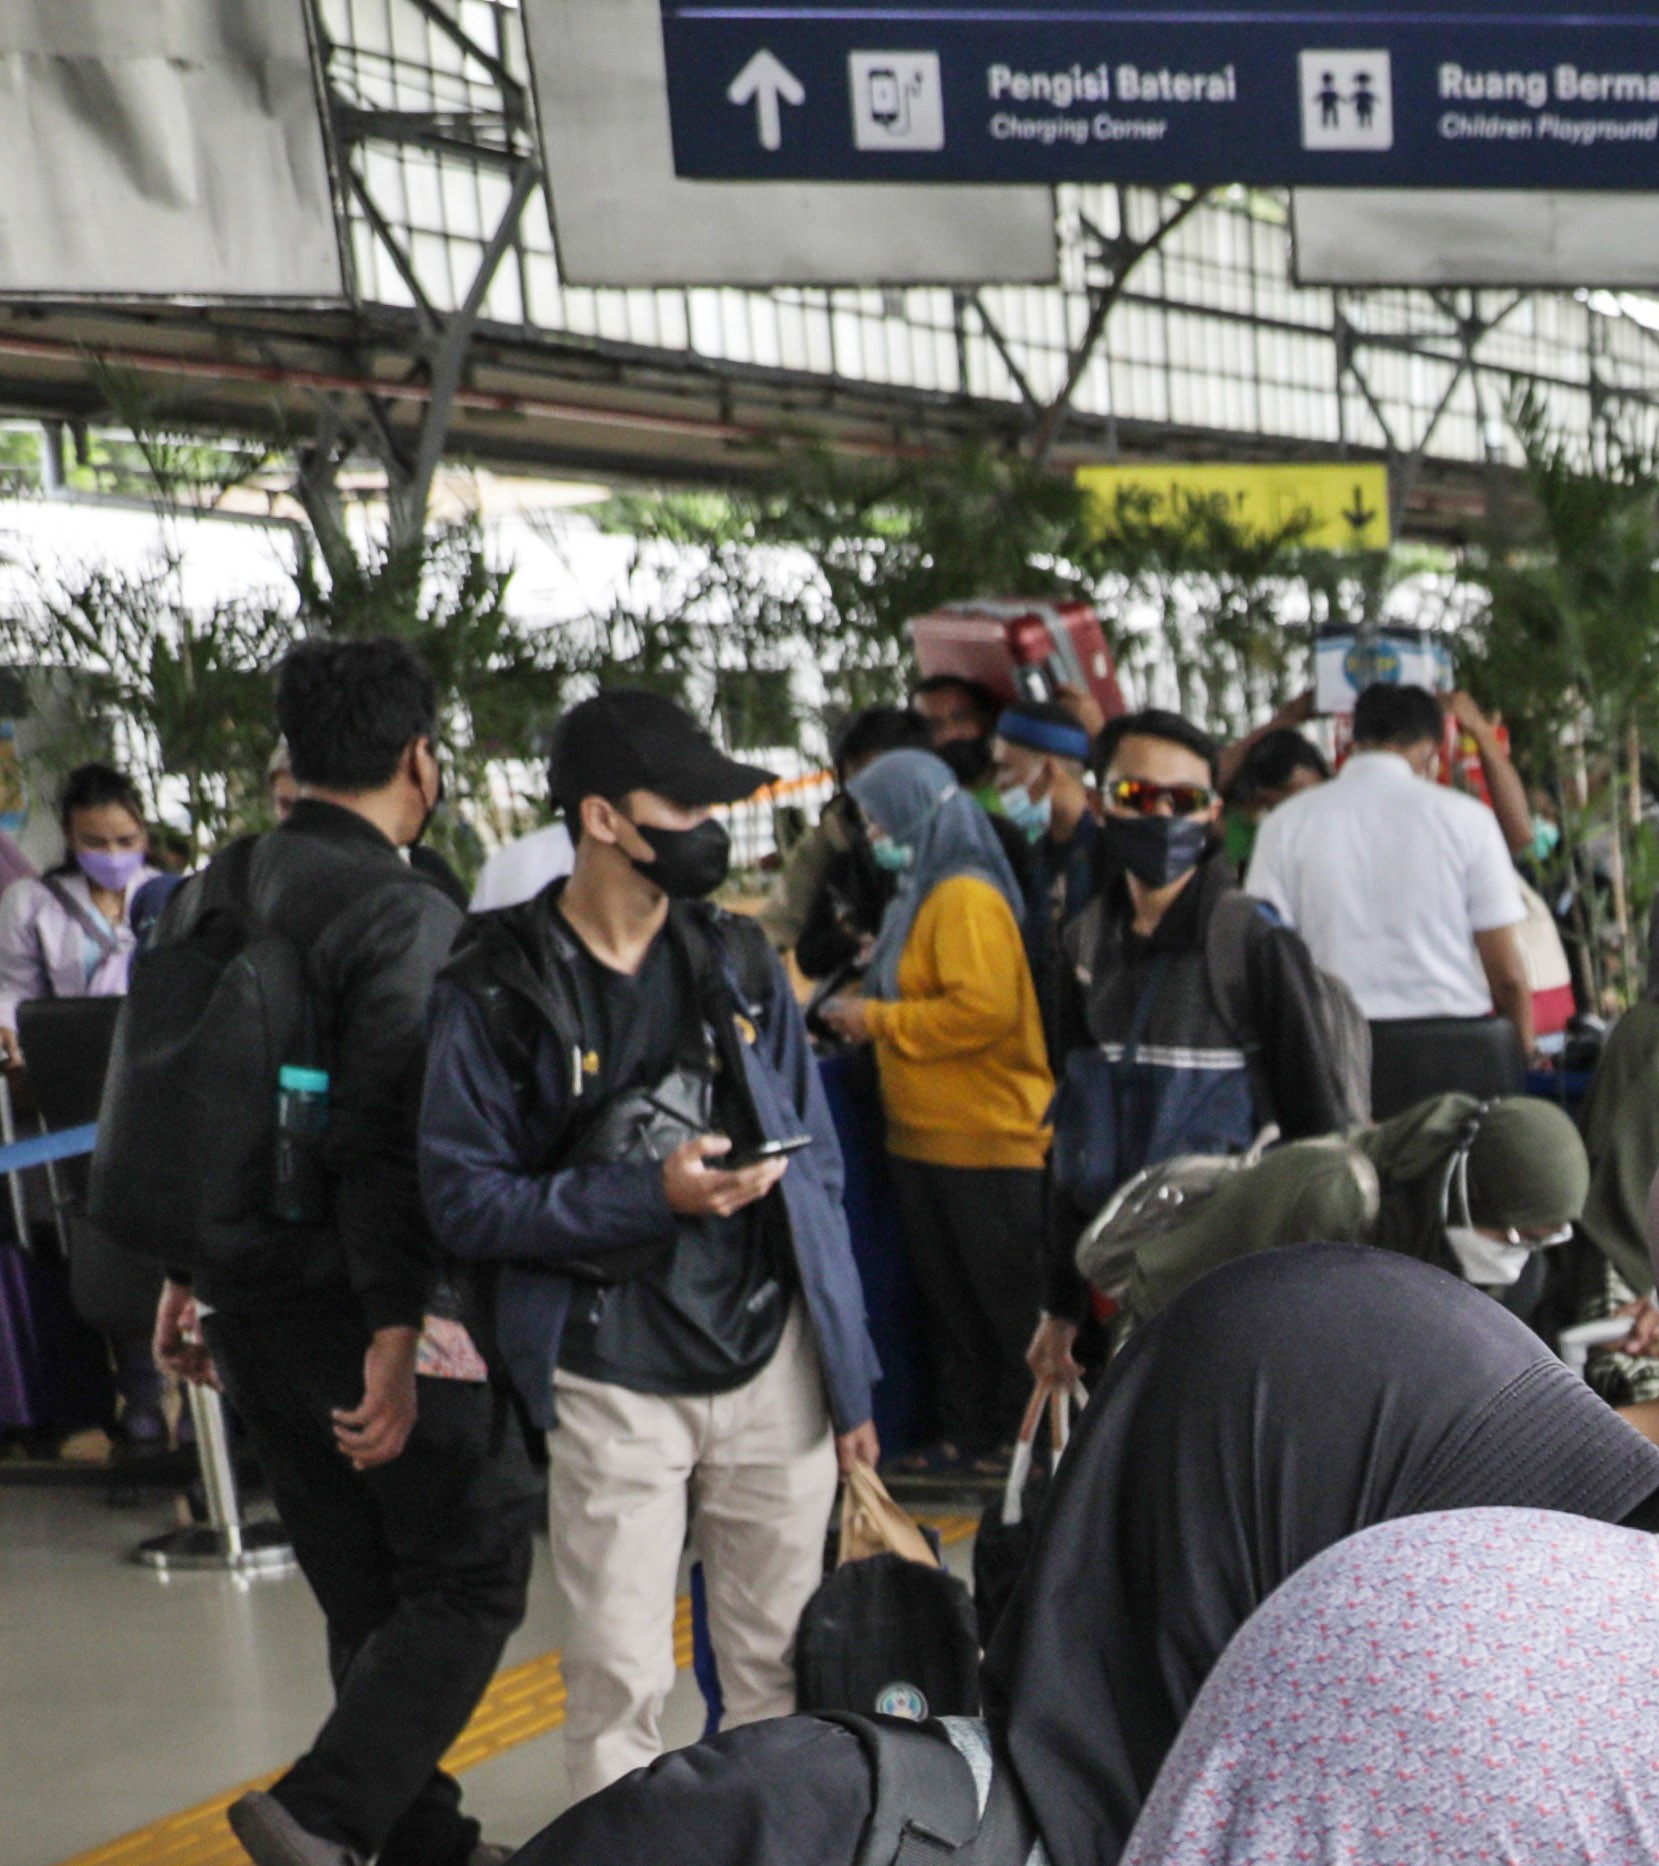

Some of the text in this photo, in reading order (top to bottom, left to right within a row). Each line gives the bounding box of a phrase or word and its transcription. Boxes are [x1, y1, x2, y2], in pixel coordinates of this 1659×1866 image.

[988, 62, 1238, 109] Pengisi Baterai
[1439, 62, 1548, 108] Ruang
[989, 112, 1168, 145] Charging Corner
[1439, 113, 1659, 146] Children Playground
